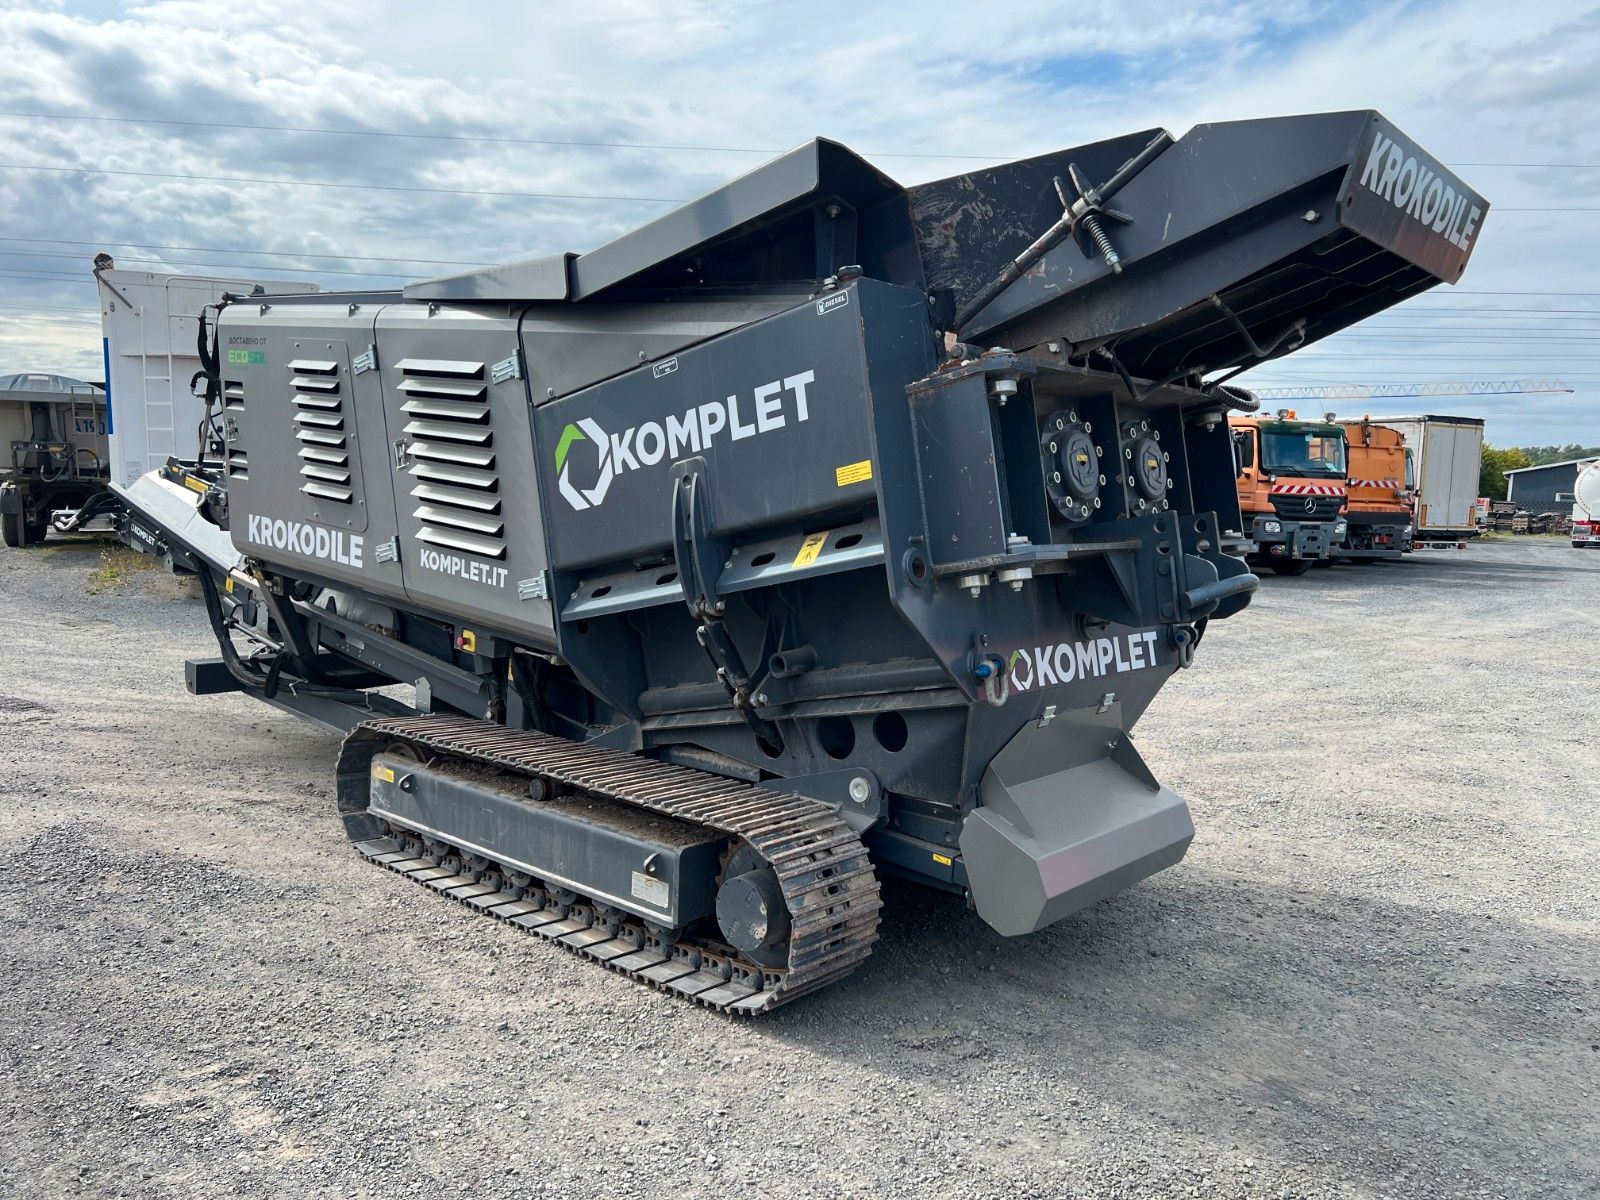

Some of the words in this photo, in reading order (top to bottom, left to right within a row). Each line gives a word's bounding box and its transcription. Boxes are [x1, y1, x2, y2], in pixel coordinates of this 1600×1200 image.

[1360, 131, 1481, 252] KROKODILE
[825, 295, 845, 308] DIESEL
[610, 369, 815, 475] KOMPLET
[134, 525, 155, 546] KOMPLET
[248, 514, 364, 569] KROKODILE
[420, 548, 508, 588] KOMPLET.IT
[1035, 631, 1157, 687] KOMPLET
